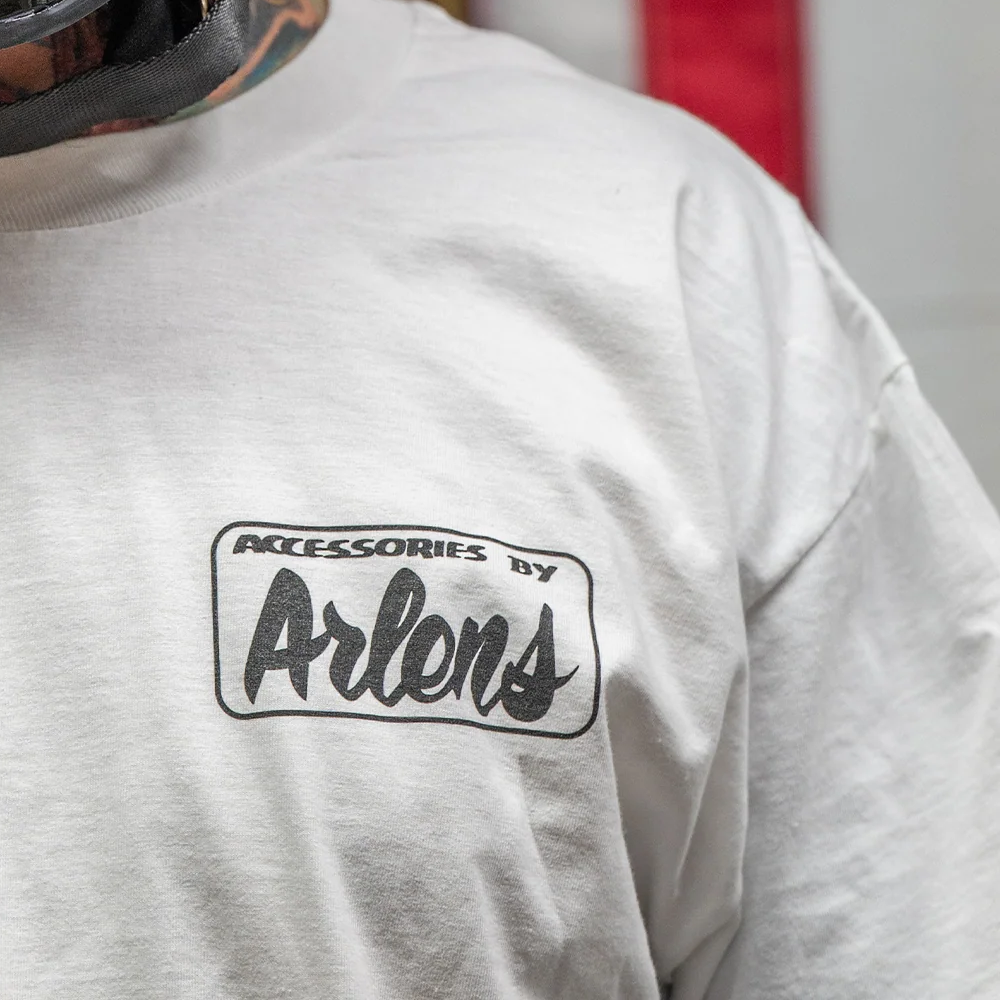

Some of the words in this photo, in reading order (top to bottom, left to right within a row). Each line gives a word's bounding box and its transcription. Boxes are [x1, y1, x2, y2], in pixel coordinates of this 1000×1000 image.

[233, 534, 487, 561] ACCESSORIES
[507, 555, 558, 582] BY
[244, 567, 580, 722] Arlens
